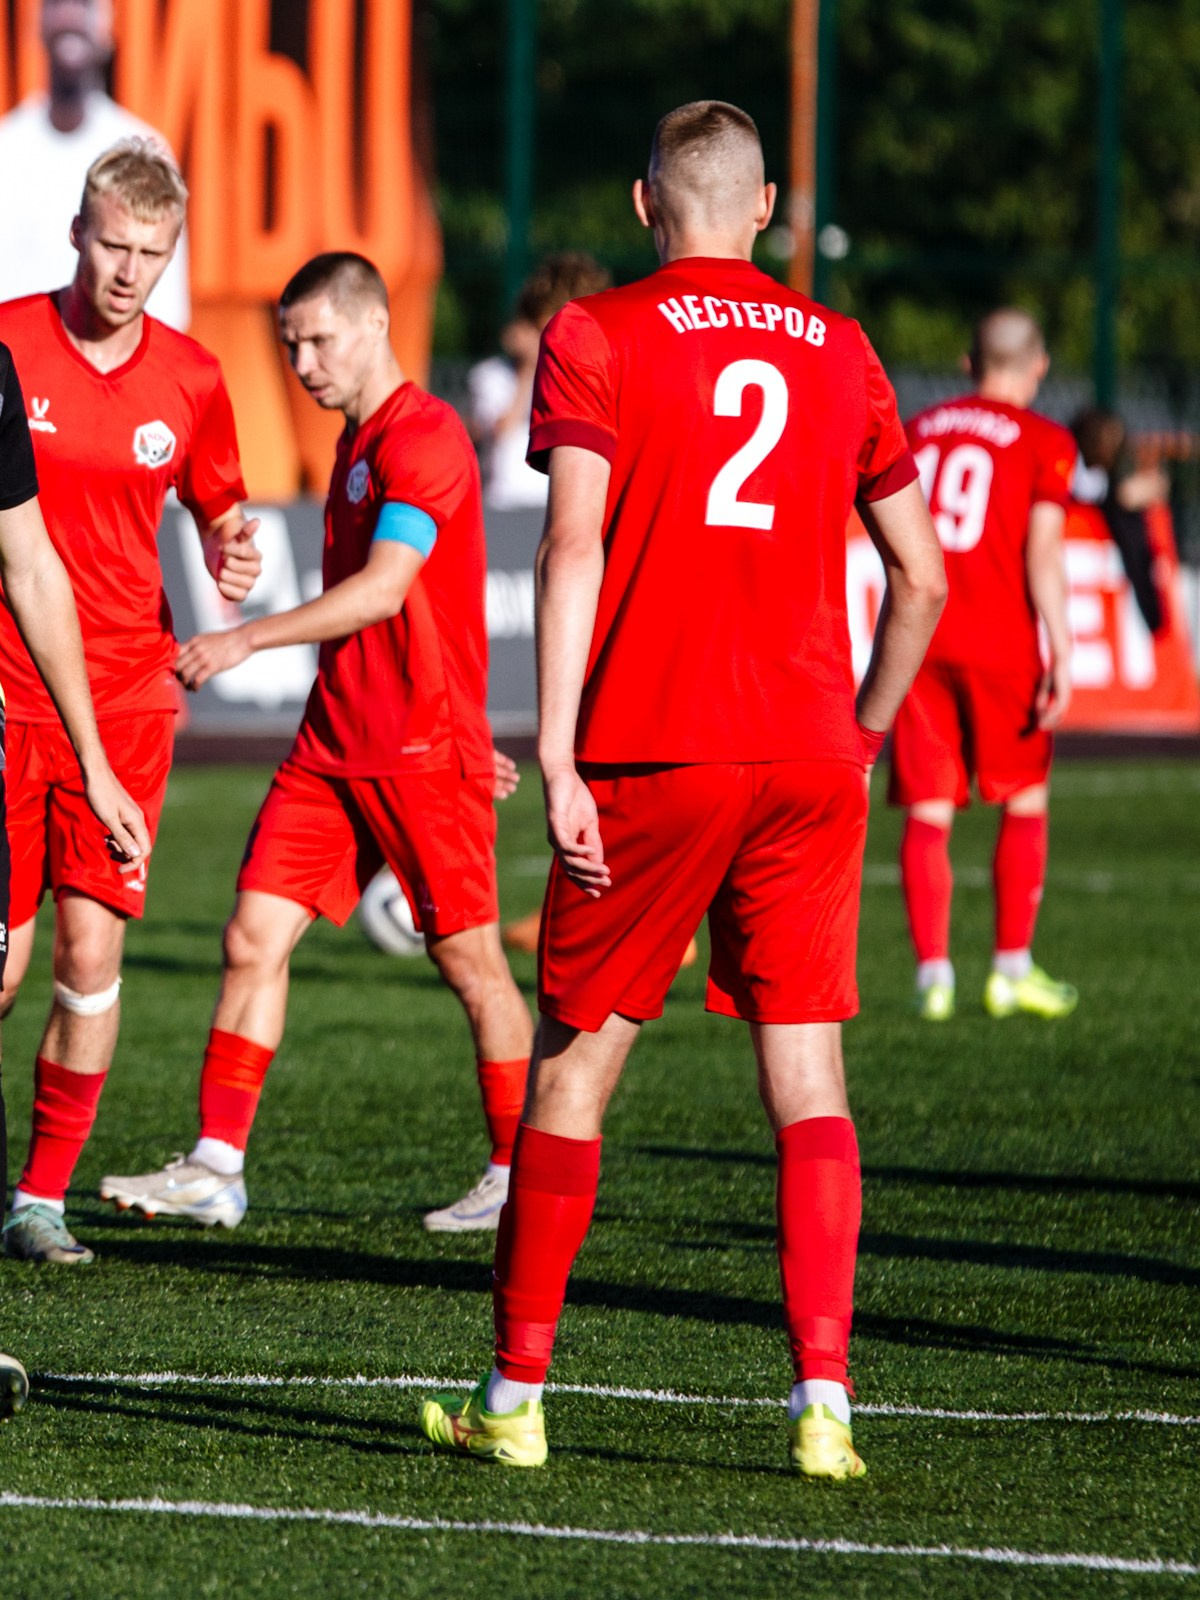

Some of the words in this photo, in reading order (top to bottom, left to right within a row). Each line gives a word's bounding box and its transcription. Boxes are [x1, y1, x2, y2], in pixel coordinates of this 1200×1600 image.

[657, 295, 827, 347] НЕСТЕРОВ
[705, 358, 789, 530] 2
[913, 441, 994, 553] 19
